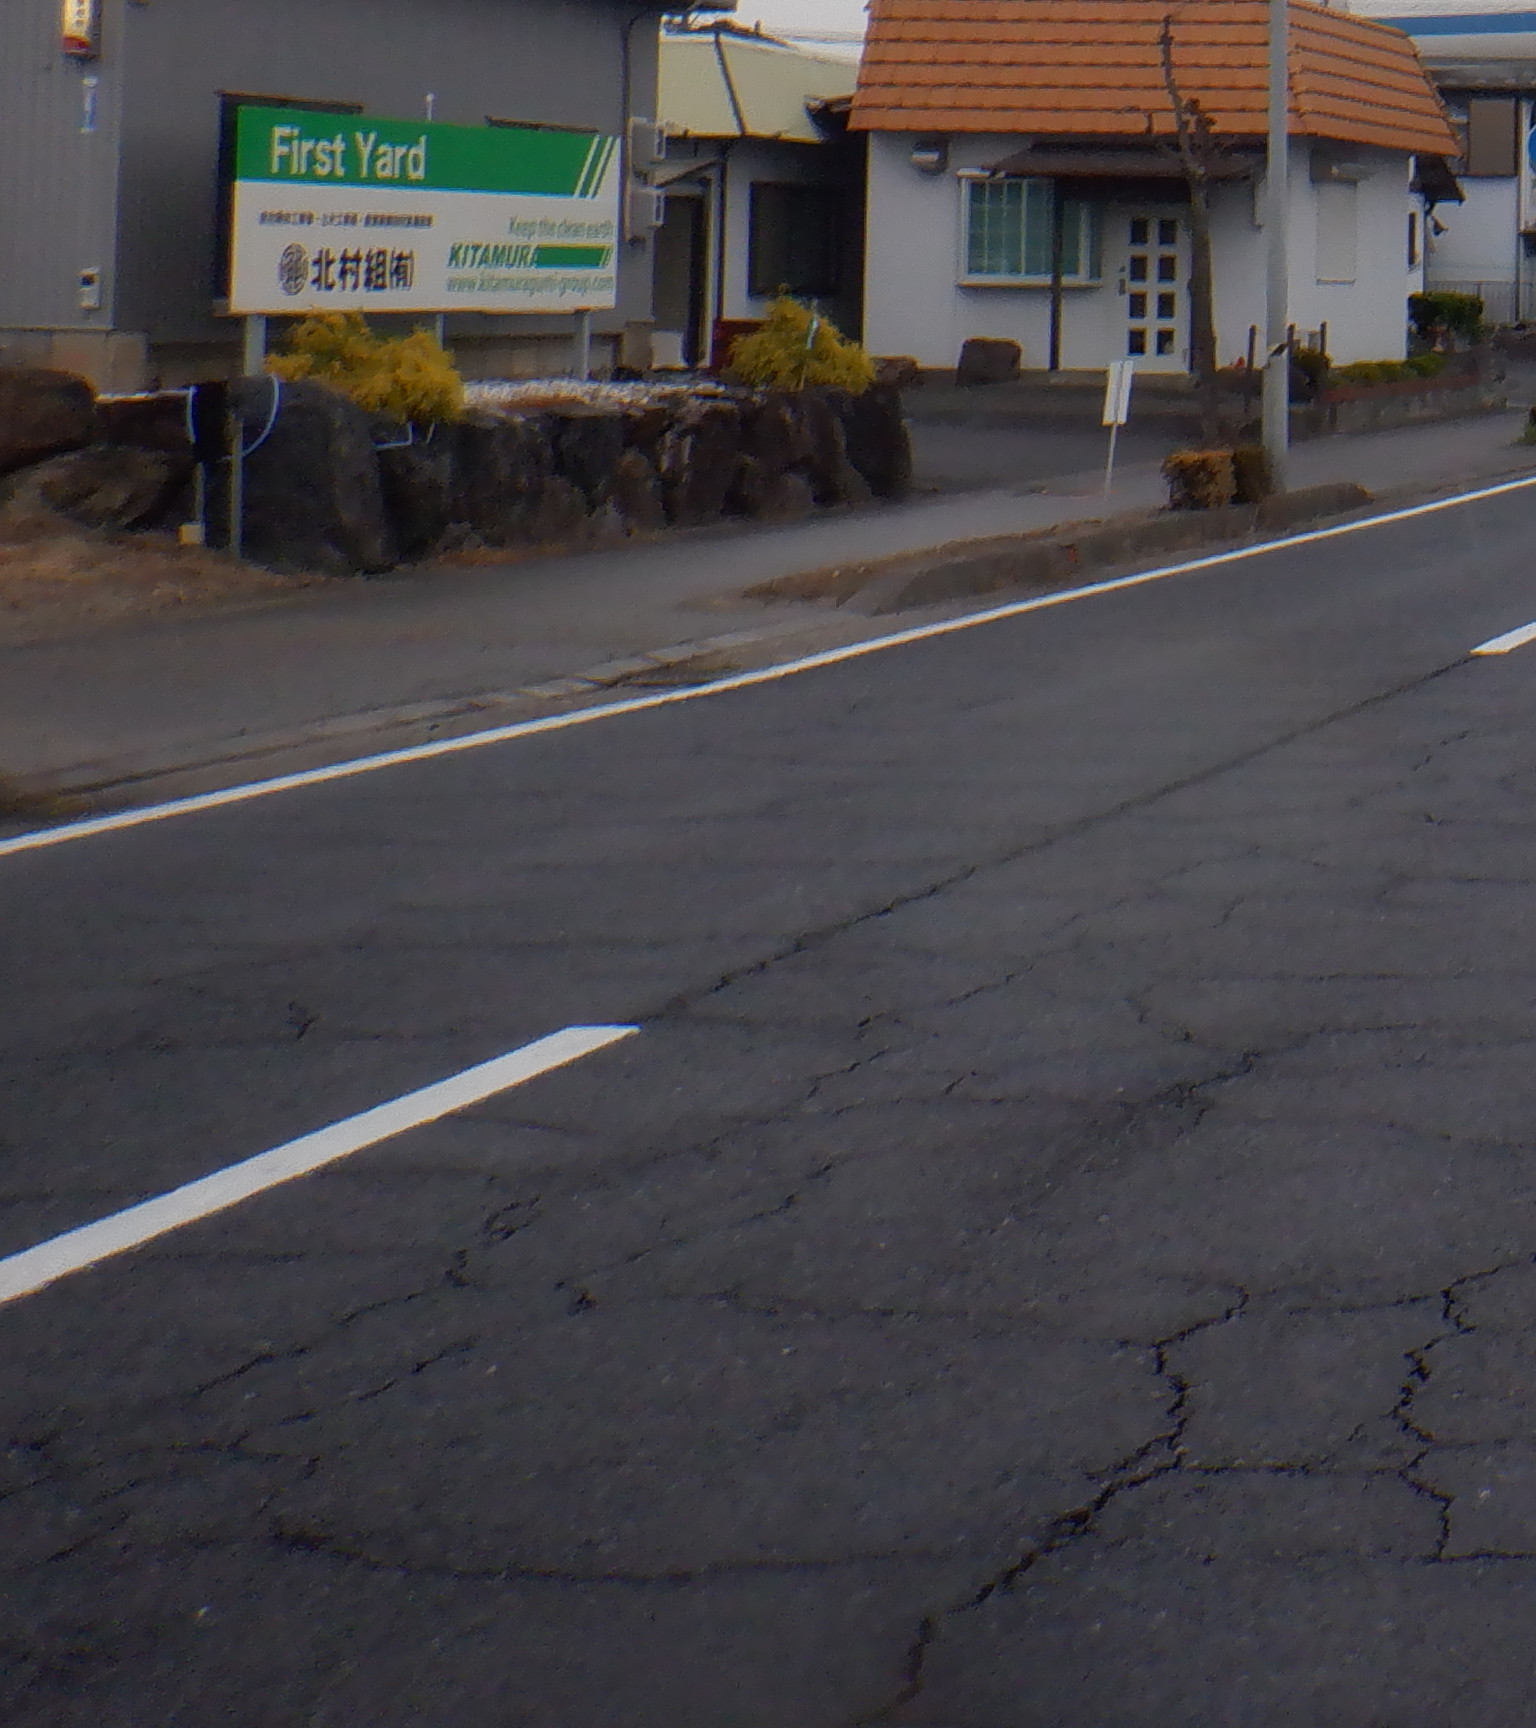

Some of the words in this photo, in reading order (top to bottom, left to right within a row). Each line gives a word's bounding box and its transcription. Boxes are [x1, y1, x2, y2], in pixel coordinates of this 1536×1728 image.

[270, 125, 345, 178] First
[355, 130, 427, 181] Yard
[448, 244, 541, 269] KITAMURA
